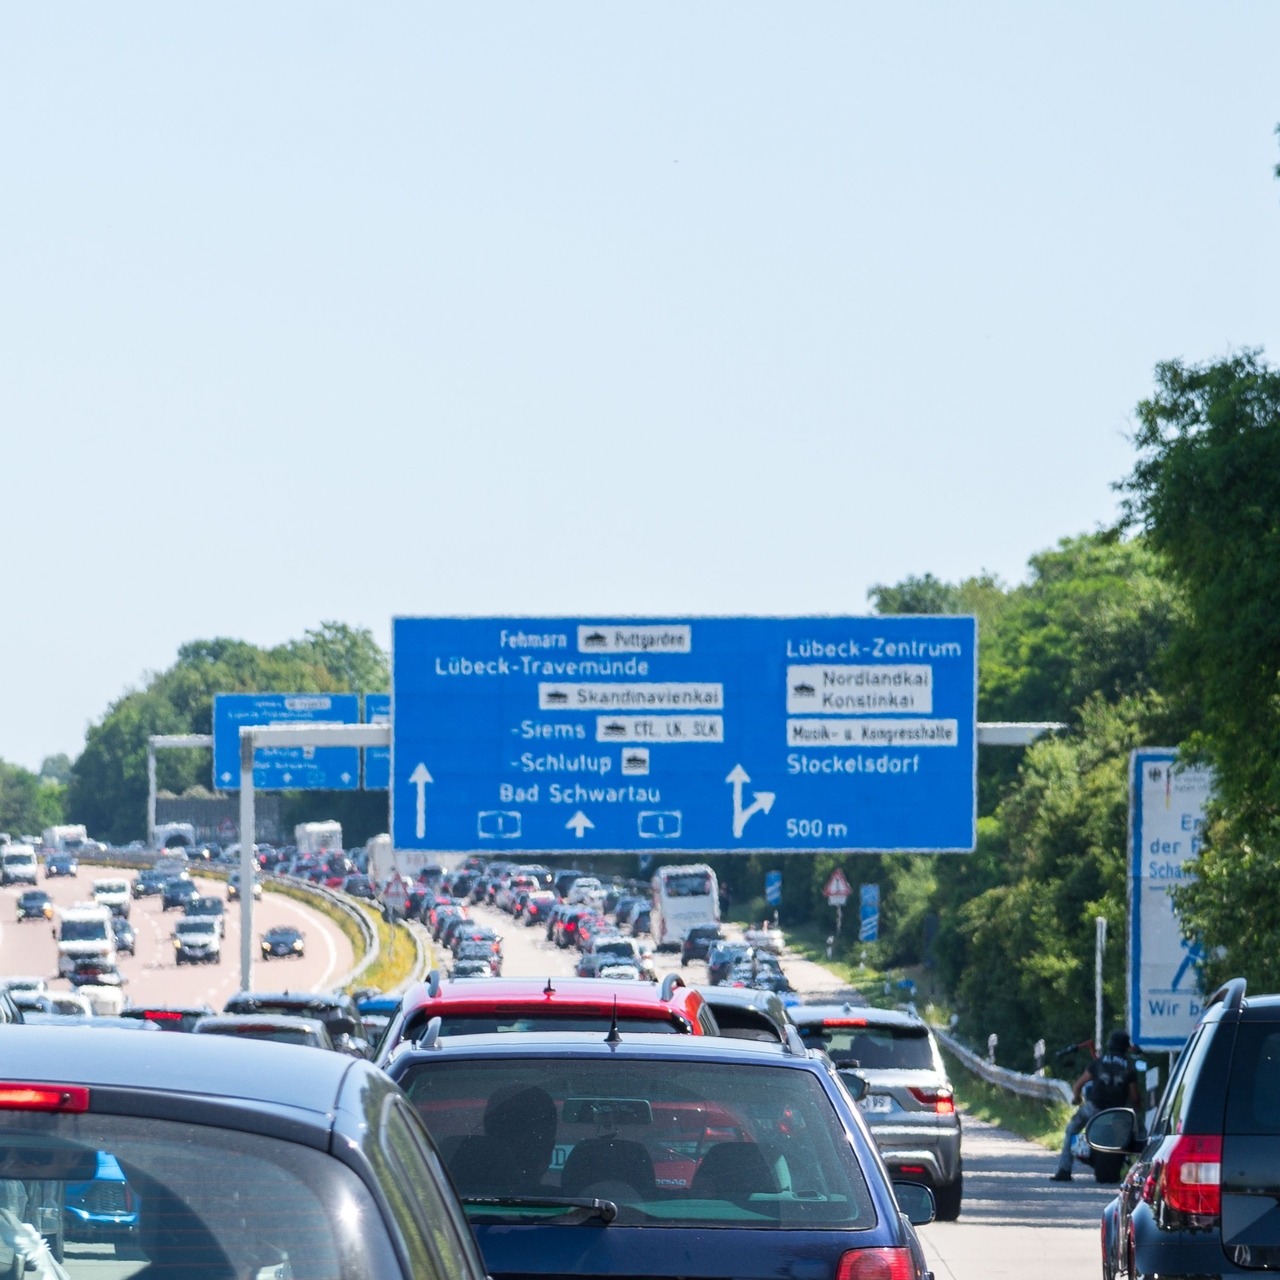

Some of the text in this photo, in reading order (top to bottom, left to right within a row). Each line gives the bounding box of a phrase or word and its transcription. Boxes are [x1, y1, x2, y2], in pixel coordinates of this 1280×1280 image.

[500, 630, 685, 651] Fehmarn Puttgarden
[786, 637, 962, 659] Lübeck-Zentrum
[434, 656, 650, 677] Lübeck-Travemünde
[822, 671, 928, 688] Nordlandkai
[576, 688, 719, 706] Skandinavienkai
[822, 692, 915, 709] Konstinkai
[792, 726, 839, 741] Musik-
[861, 725, 953, 745] Kongresshalle
[786, 754, 920, 774] Stockelsdorf
[499, 783, 661, 804] Bad Schwartau
[786, 819, 848, 838] 500 m
[1149, 838, 1181, 854] der
[1148, 999, 1180, 1016] Wir
